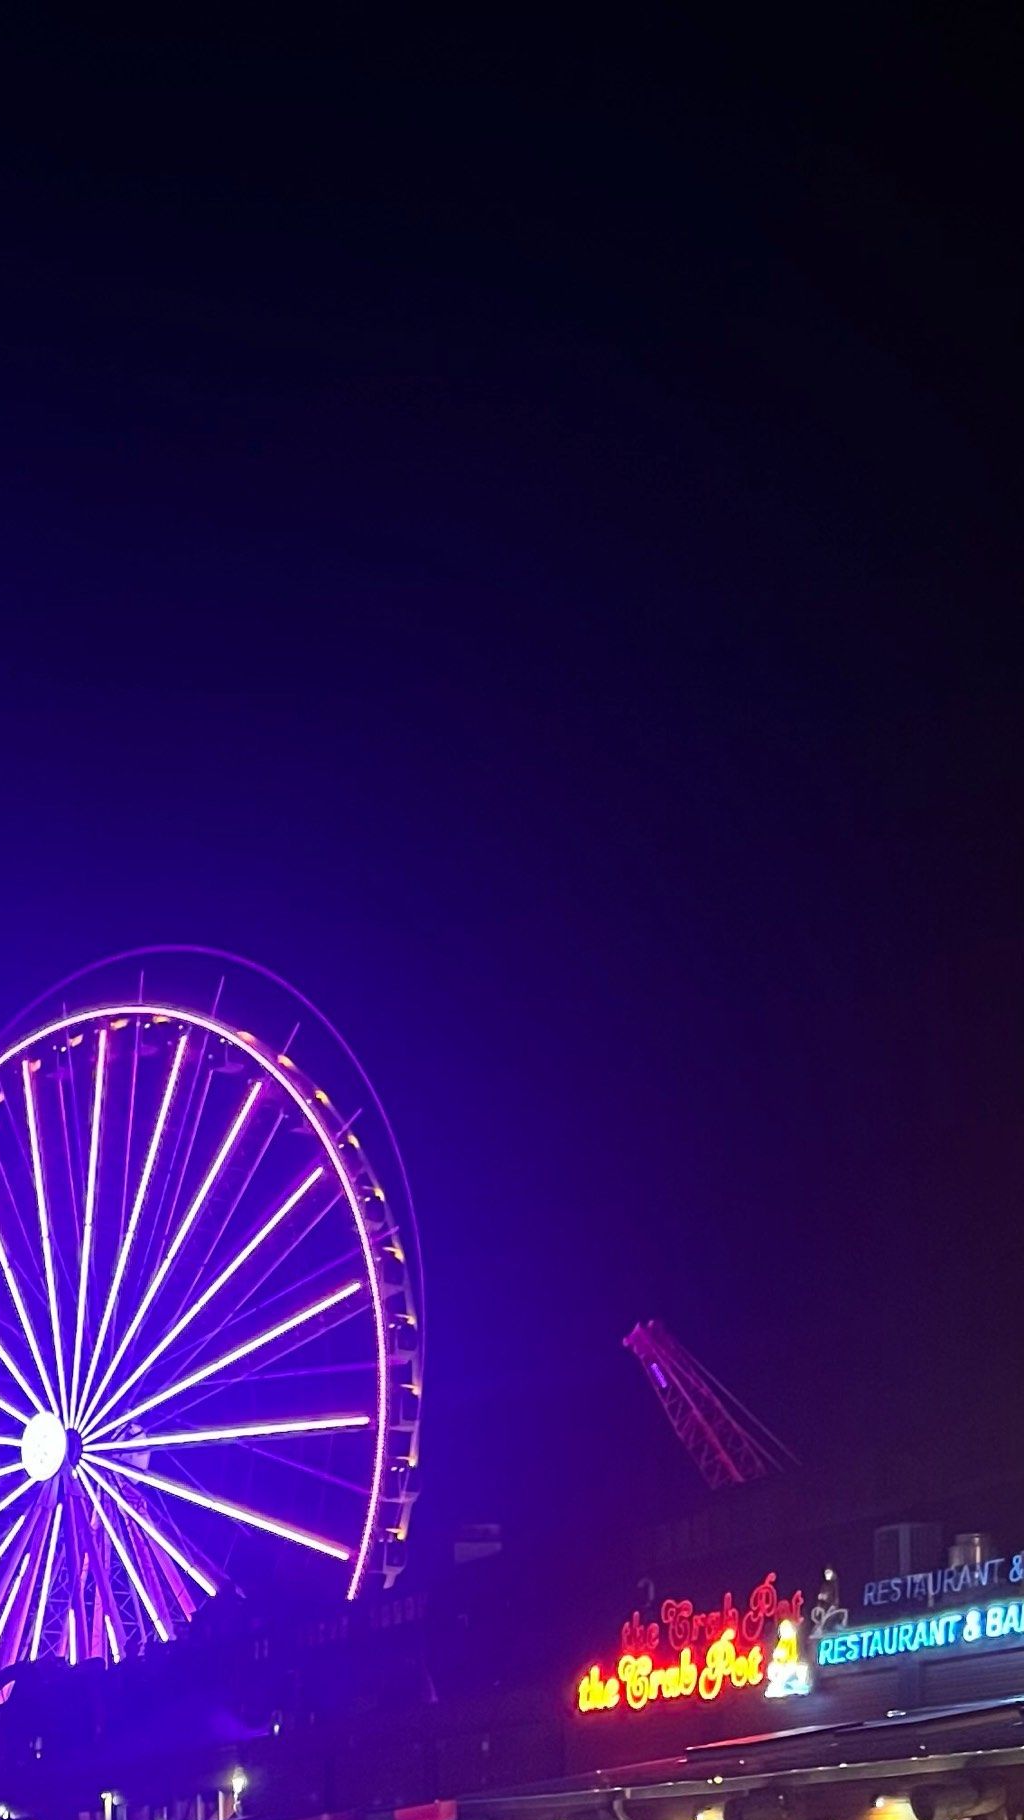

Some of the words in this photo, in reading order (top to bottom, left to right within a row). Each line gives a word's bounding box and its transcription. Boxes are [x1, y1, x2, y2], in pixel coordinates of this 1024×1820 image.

[621, 1611, 659, 1652] the
[742, 1571, 804, 1642] Pot
[863, 1557, 1005, 1606] RESTAURANT
[578, 1664, 620, 1712] the
[618, 1654, 697, 1710] Crab
[698, 1627, 764, 1700] Pot
[818, 1614, 963, 1666] RESTAURANT
[962, 1609, 983, 1642] &
[985, 1602, 1024, 1639] BA
